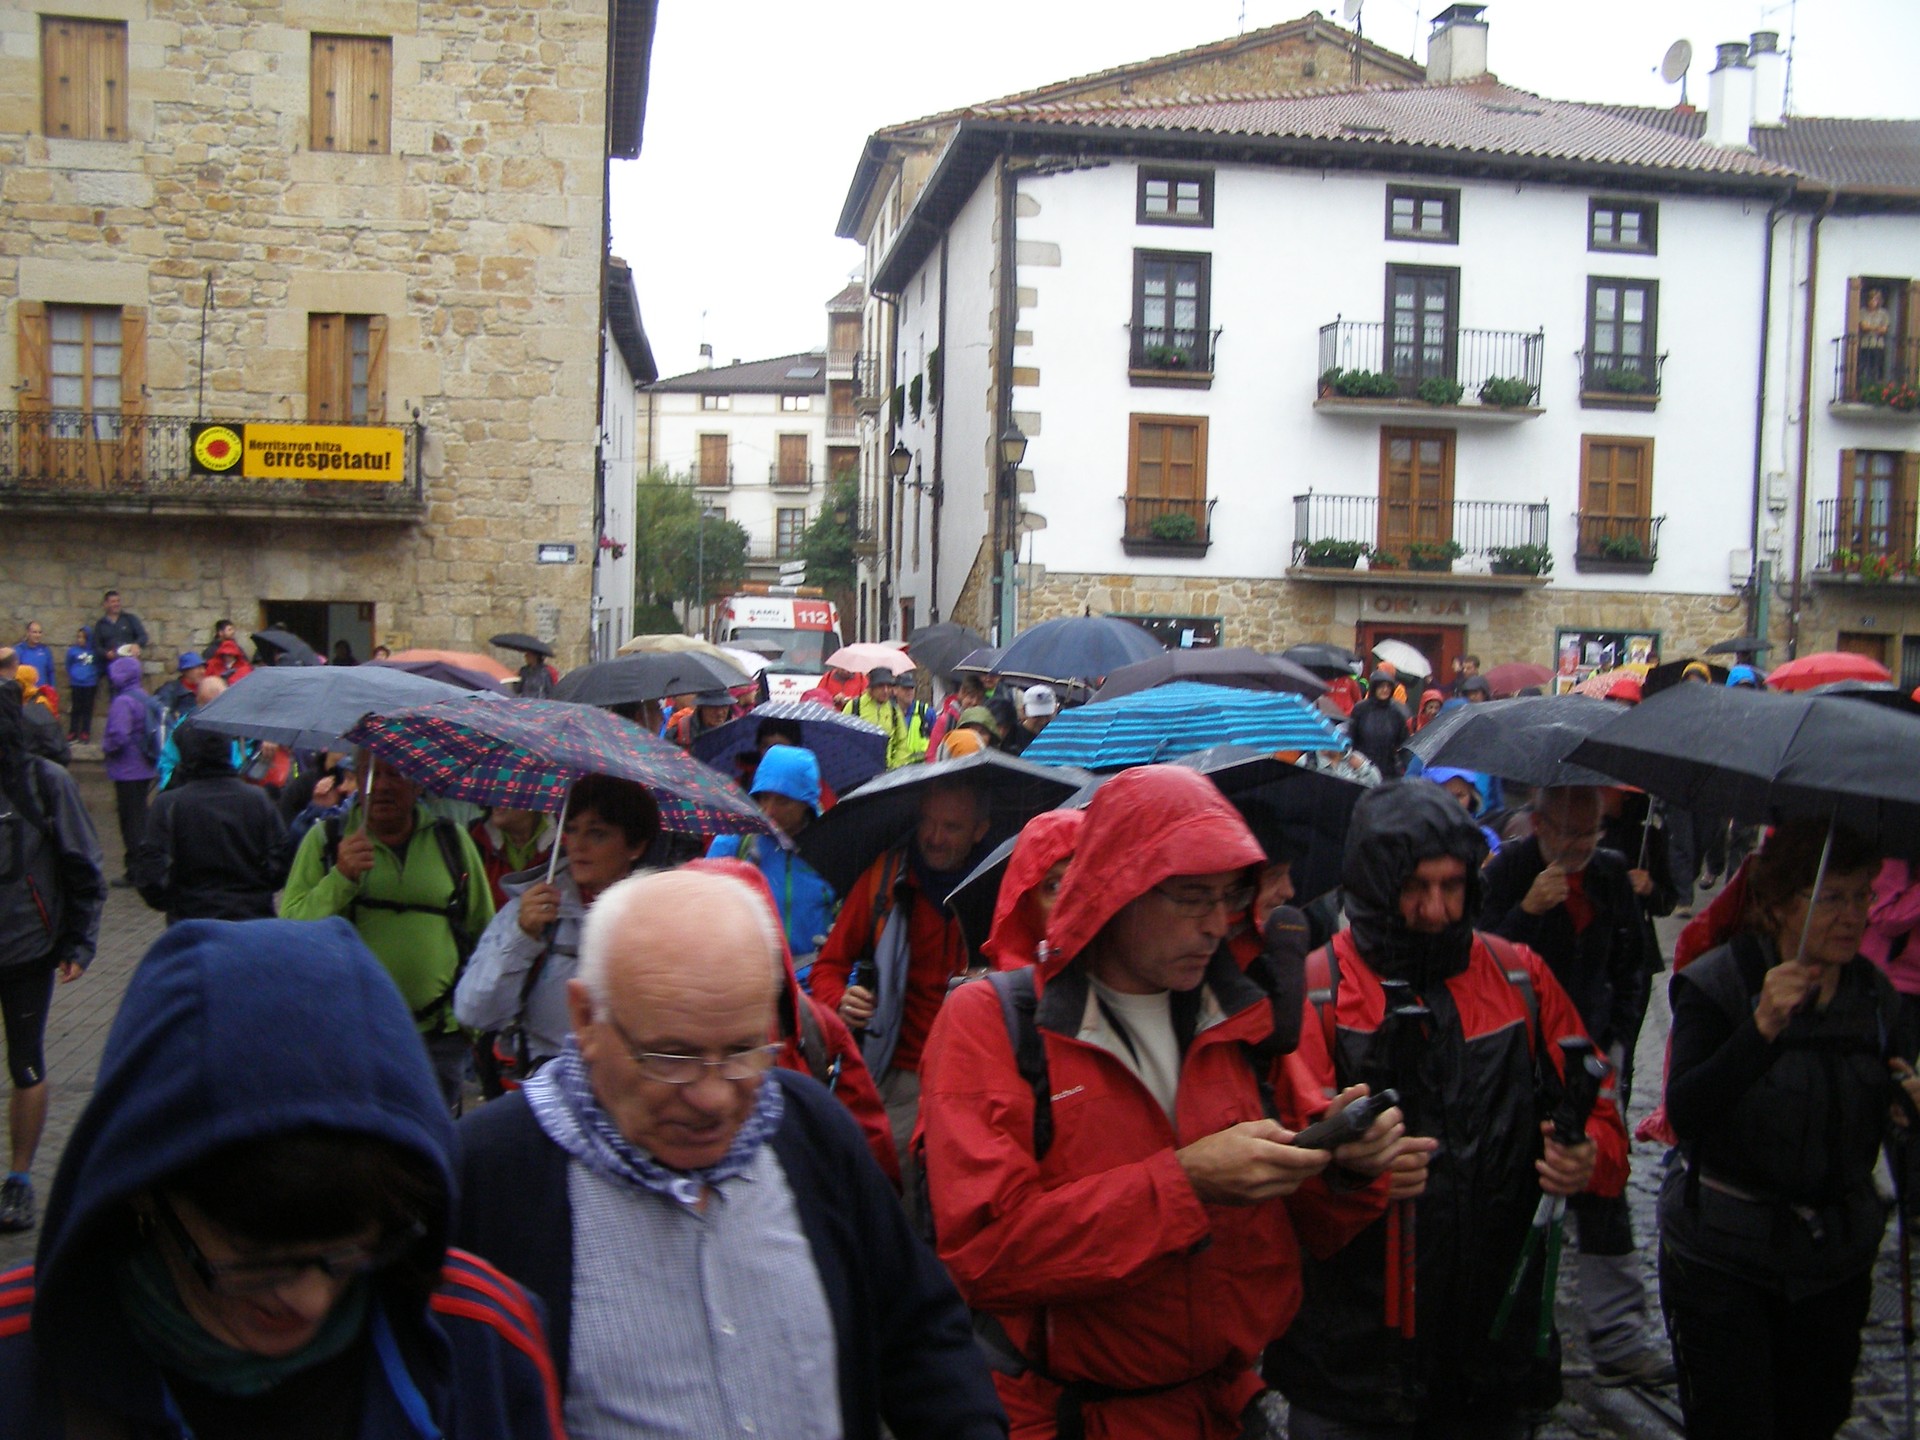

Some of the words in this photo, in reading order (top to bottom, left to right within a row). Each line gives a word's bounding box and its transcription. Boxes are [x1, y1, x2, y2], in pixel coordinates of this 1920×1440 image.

[249, 440, 312, 452] Herritarron
[315, 441, 342, 452] hitza
[263, 451, 391, 471] errespetatu!
[798, 610, 829, 625] 112
